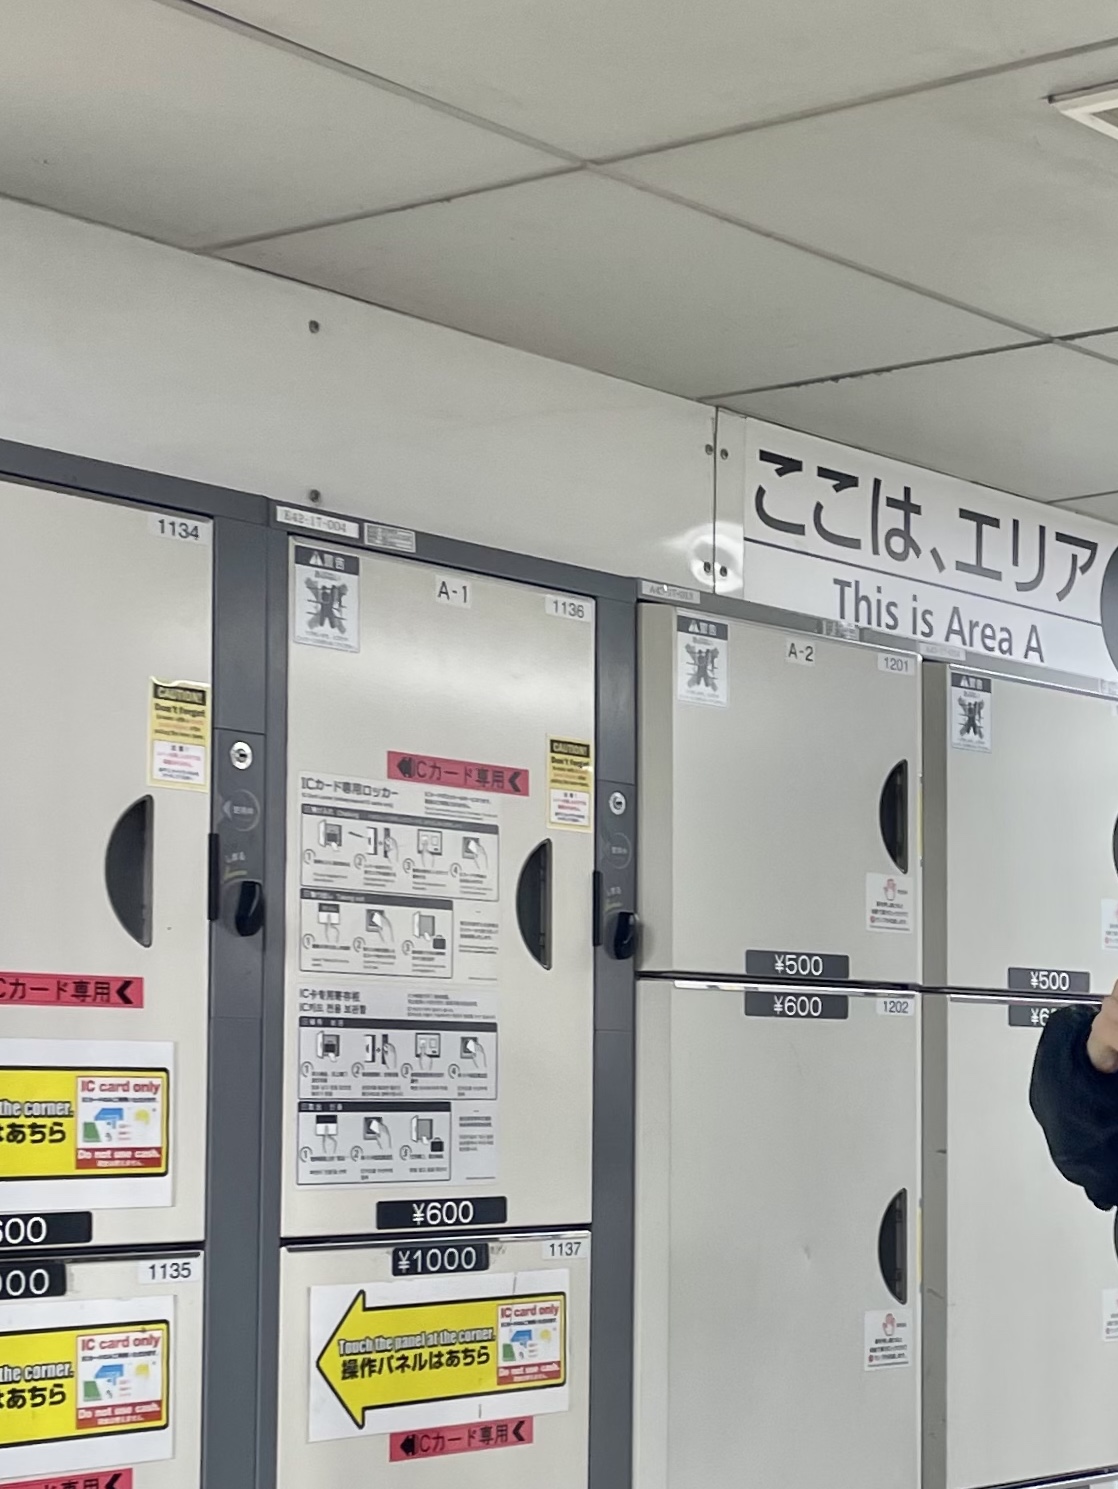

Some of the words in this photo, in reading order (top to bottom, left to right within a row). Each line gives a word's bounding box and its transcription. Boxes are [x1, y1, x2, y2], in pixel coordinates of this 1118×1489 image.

[158, 519, 199, 540] 1134
[755, 449, 1098, 601] ここは、エリア
[437, 581, 468, 603] A-1
[552, 600, 585, 619] 1136
[833, 578, 899, 630] This
[911, 595, 934, 638] is
[945, 607, 1013, 656] Area
[1024, 624, 1045, 664] A
[788, 643, 814, 662] A-2
[884, 656, 909, 673] 1201
[775, 954, 823, 976] ¥500
[1030, 971, 1070, 991] ¥500
[774, 995, 822, 1017] ¥600
[883, 1000, 909, 1014] 1202
[81, 1080, 96, 1092] IC
[99, 1080, 130, 1092] card
[133, 1081, 161, 1095] only
[412, 1200, 474, 1226] ¥600
[0, 1216, 47, 1244] 00
[550, 1242, 582, 1256] 1137
[398, 1247, 477, 1273] ¥1000
[149, 1262, 192, 1280] 1135
[0, 1268, 49, 1297] 00
[501, 1307, 512, 1318] IC
[513, 1304, 537, 1317] card
[538, 1304, 559, 1316] only
[81, 1338, 95, 1351] IC
[99, 1336, 130, 1350] card
[133, 1334, 161, 1348] only
[338, 1336, 374, 1357] Touch
[374, 1335, 394, 1352] the
[394, 1331, 426, 1352] panel
[426, 1330, 439, 1347] at
[439, 1329, 457, 1347] the
[341, 1346, 490, 1380] 操作パネルはあちら
